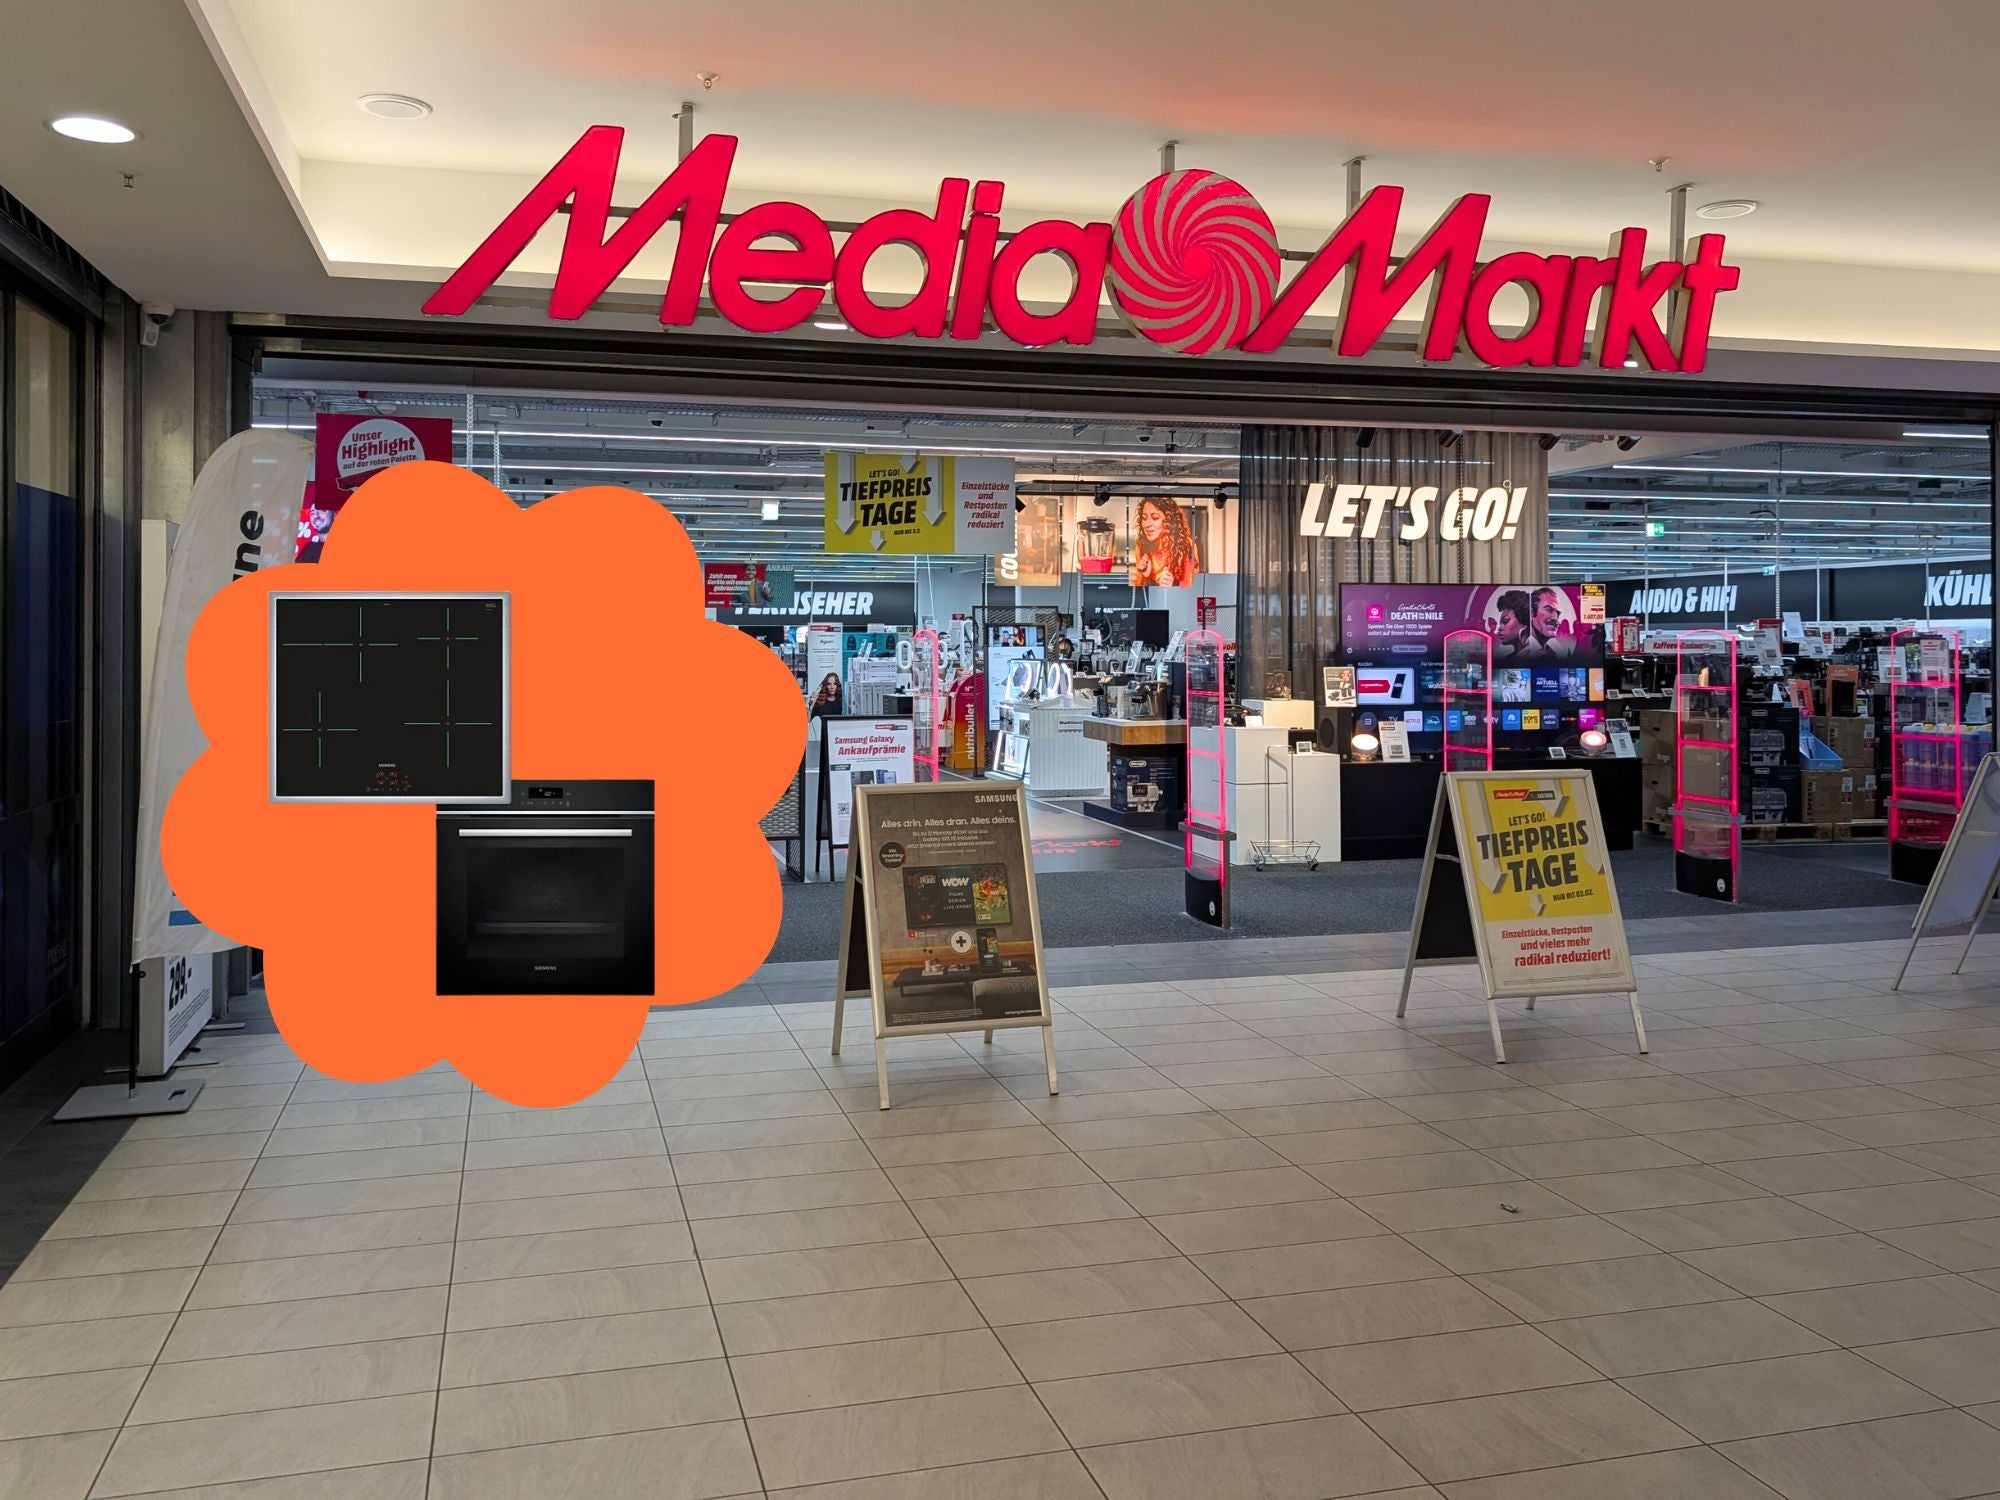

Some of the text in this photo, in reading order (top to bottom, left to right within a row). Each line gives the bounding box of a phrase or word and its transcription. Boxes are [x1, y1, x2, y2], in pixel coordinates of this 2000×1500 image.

[421, 124, 1740, 373] Media Markt
[351, 431, 383, 443] Unser
[341, 436, 416, 460] Highlight
[342, 461, 356, 470] auf
[356, 460, 369, 468] der
[369, 458, 390, 467] roten
[869, 468, 900, 478] LET'S GO!
[840, 476, 933, 502] TIEFPREIS
[961, 481, 1010, 491] Einzelstücke
[978, 491, 994, 500] und
[963, 501, 1008, 511] Restposten
[1300, 483, 1528, 541] LET'S GO!
[860, 500, 917, 527] TAGE
[971, 510, 1000, 519] radikal
[967, 519, 1004, 529] reduziert
[1629, 587, 1685, 615] AUDIO
[1684, 586, 1699, 613] &
[1699, 585, 1738, 613] HIFI
[1390, 611, 1418, 621] DEATH
[1424, 611, 1444, 621] NILE
[834, 734, 895, 745] Samsung Galaxy
[837, 744, 906, 756] Ankaufprämie
[881, 815, 1017, 828] Alles drin. Alles dran. Alles deins.
[1508, 812, 1546, 826] LET'S GO!
[1476, 820, 1589, 860] TIEFPREIS
[1507, 852, 1579, 893] TAGE
[941, 877, 970, 887] WOW
[1552, 893, 1566, 902] NUR
[1566, 891, 1576, 900] BIS
[1501, 925, 1593, 939] Einzelstücke, Restposten
[1520, 937, 1591, 950] und vieles mehr
[1514, 948, 1611, 967] radikal reduziert!
